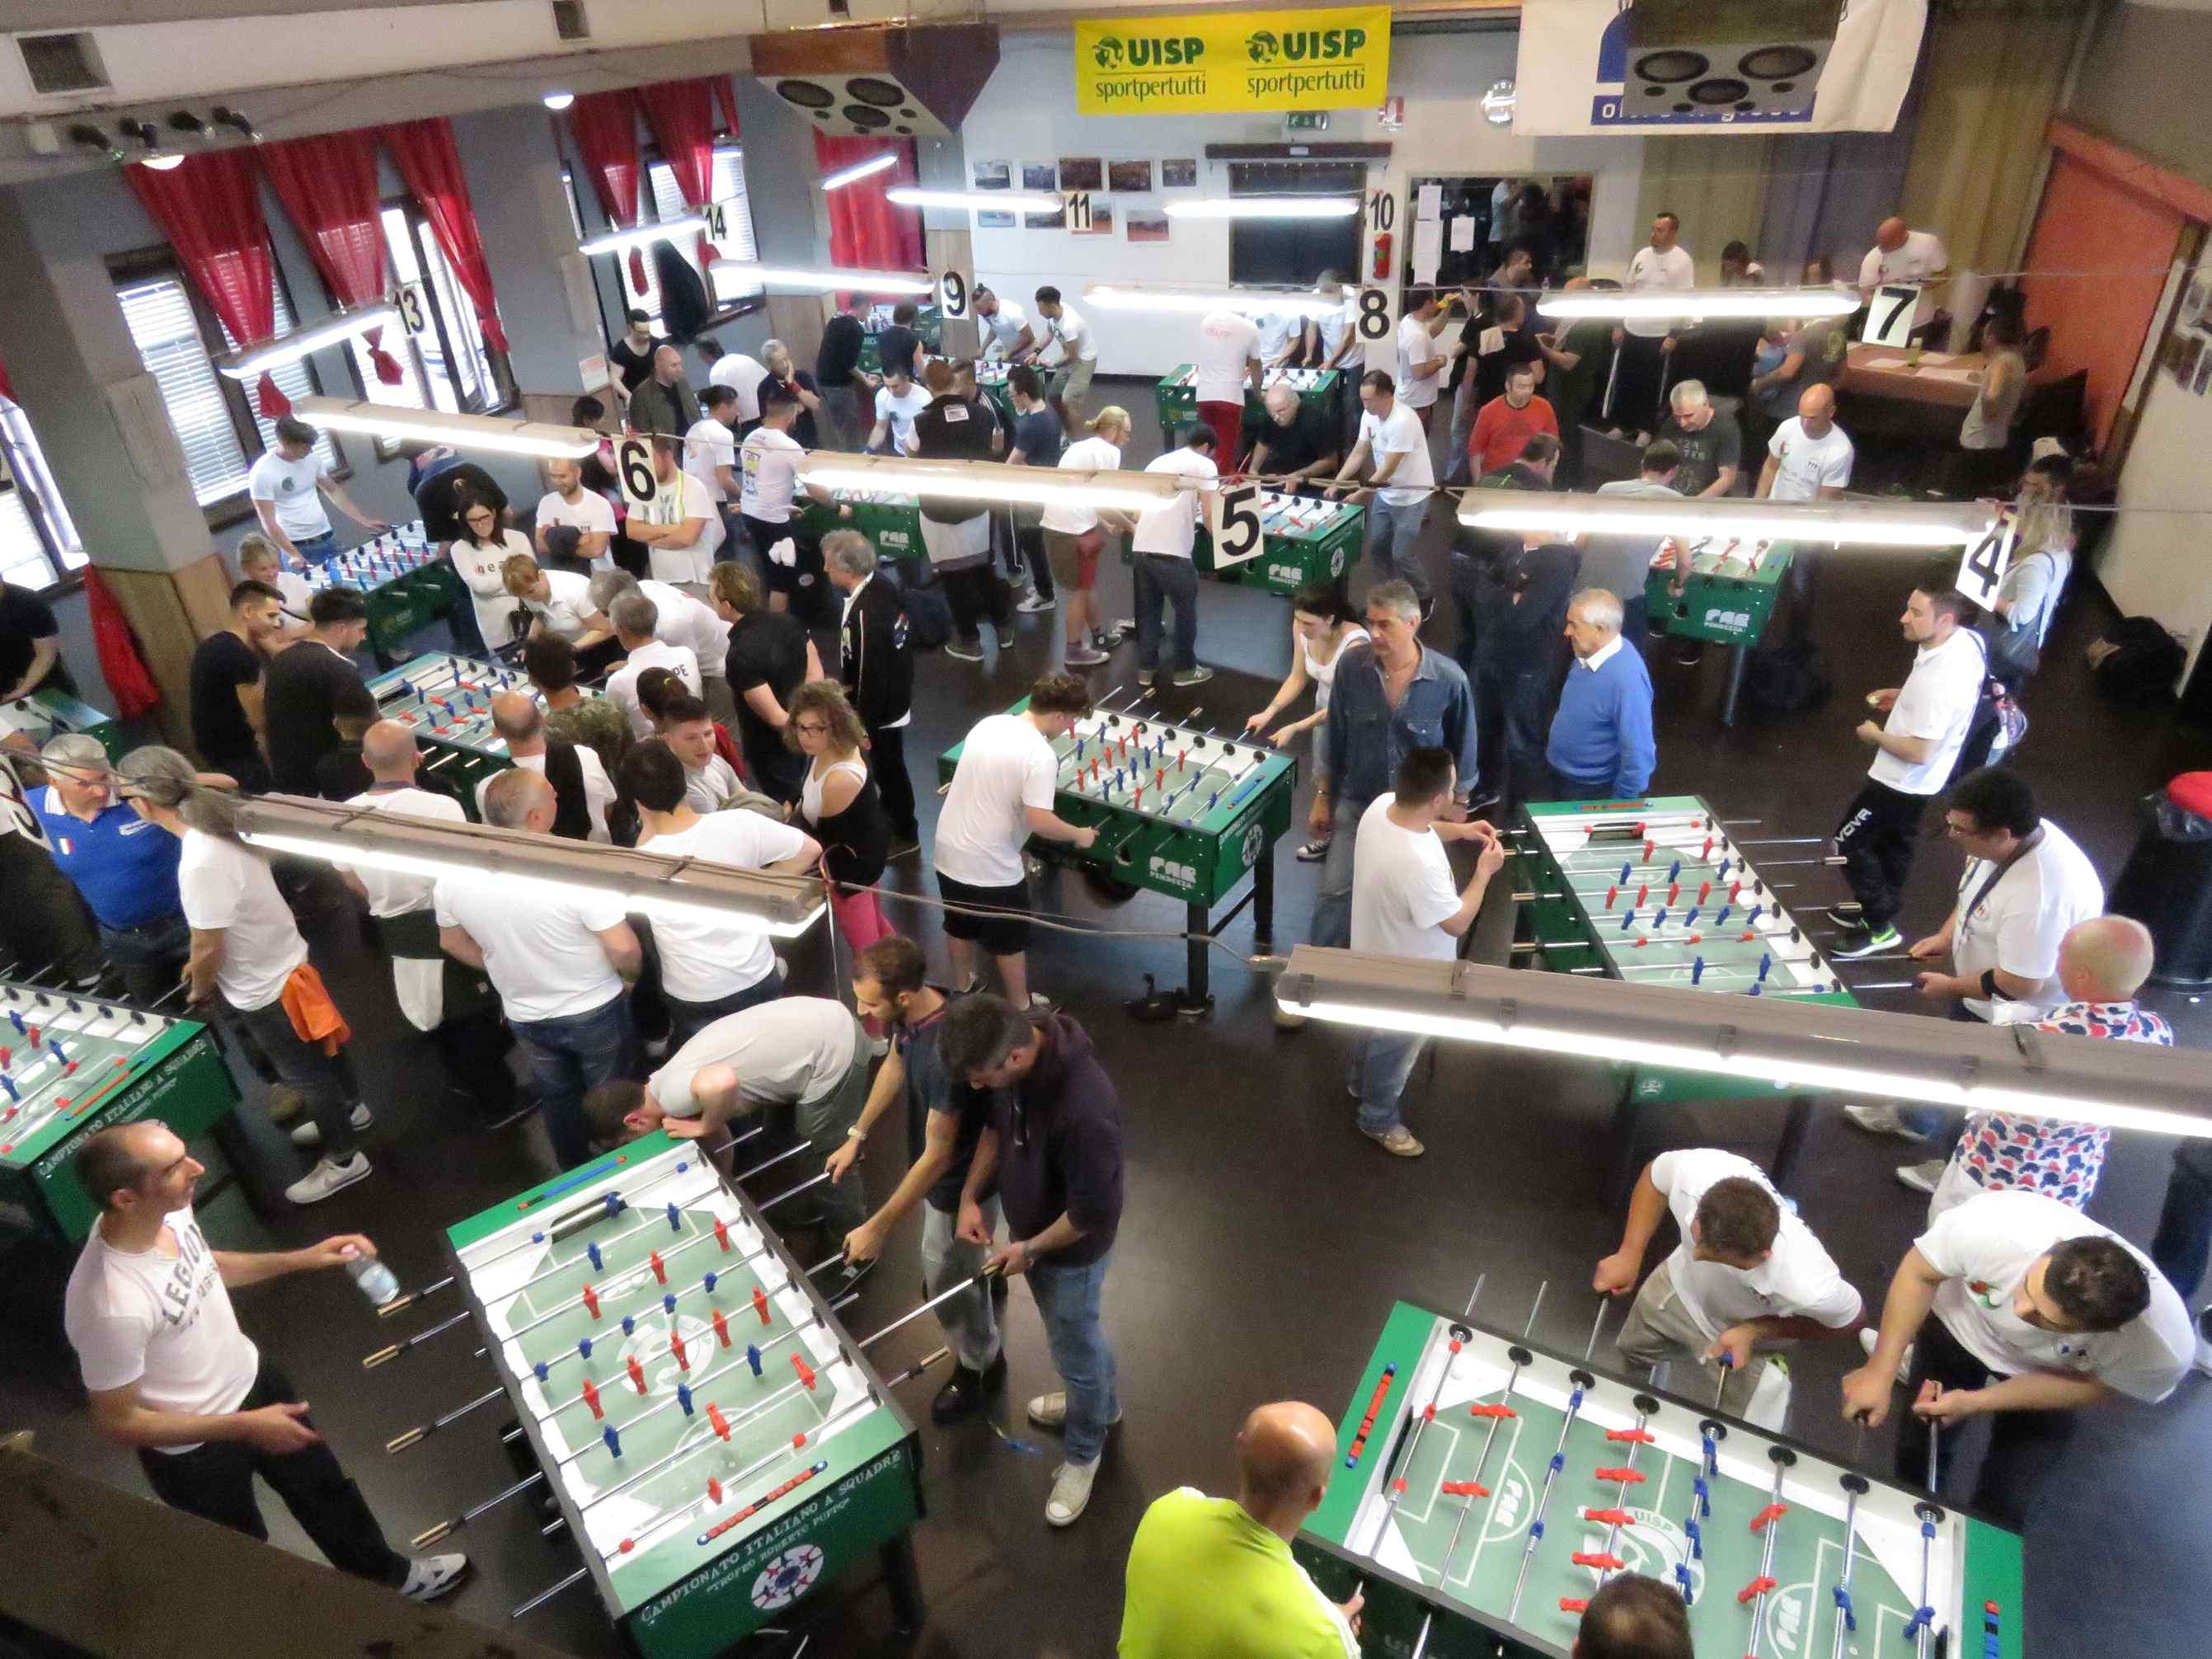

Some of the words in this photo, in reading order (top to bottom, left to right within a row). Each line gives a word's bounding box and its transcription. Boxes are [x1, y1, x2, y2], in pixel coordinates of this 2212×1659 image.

[1128, 37, 1205, 67] UISP
[1282, 28, 1367, 61] UISP
[1095, 73, 1207, 102] sportpertutti
[1246, 68, 1366, 98] sportpertutti
[705, 205, 727, 241] 14
[1068, 193, 1090, 228] 11
[1369, 193, 1395, 232] 10
[394, 289, 425, 335] 13
[943, 271, 966, 317] 9
[1359, 289, 1391, 340] 8
[1876, 286, 1918, 341] 7
[620, 440, 656, 502] 6
[1220, 486, 1261, 557] 5
[1967, 521, 2009, 599] 4
[641, 1551, 740, 1624] CAMPIONATO
[745, 1502, 820, 1556] ITALIANO
[824, 1495, 834, 1506] A
[838, 1448, 902, 1494] SQUADRE
[1633, 1509, 1674, 1533] UISP
